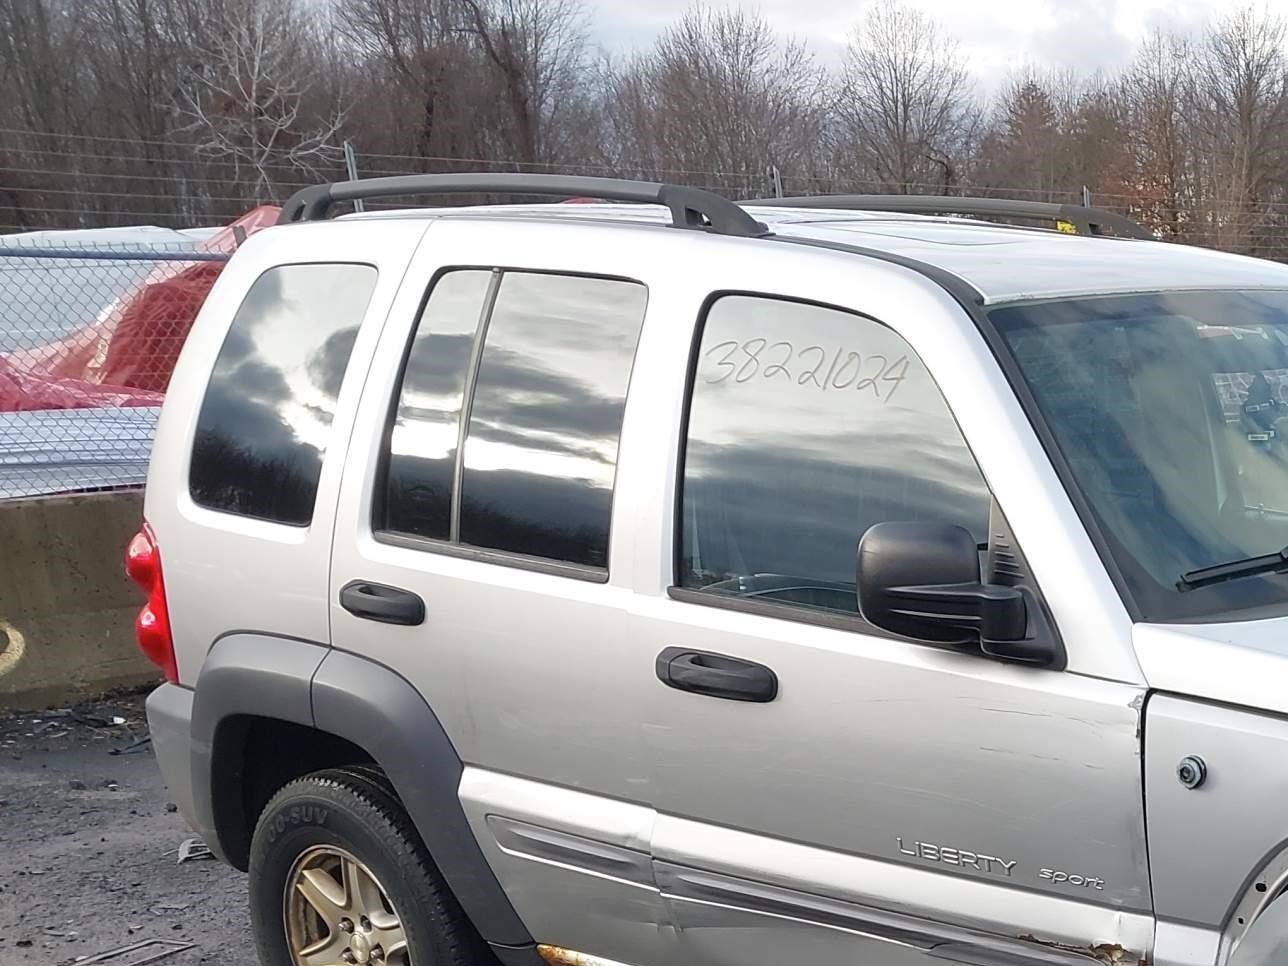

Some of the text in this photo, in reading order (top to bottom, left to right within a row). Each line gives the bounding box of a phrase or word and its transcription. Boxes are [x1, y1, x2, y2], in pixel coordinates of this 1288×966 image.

[704, 338, 910, 404] 38221024
[896, 836, 1105, 890] LIBERTY sport
